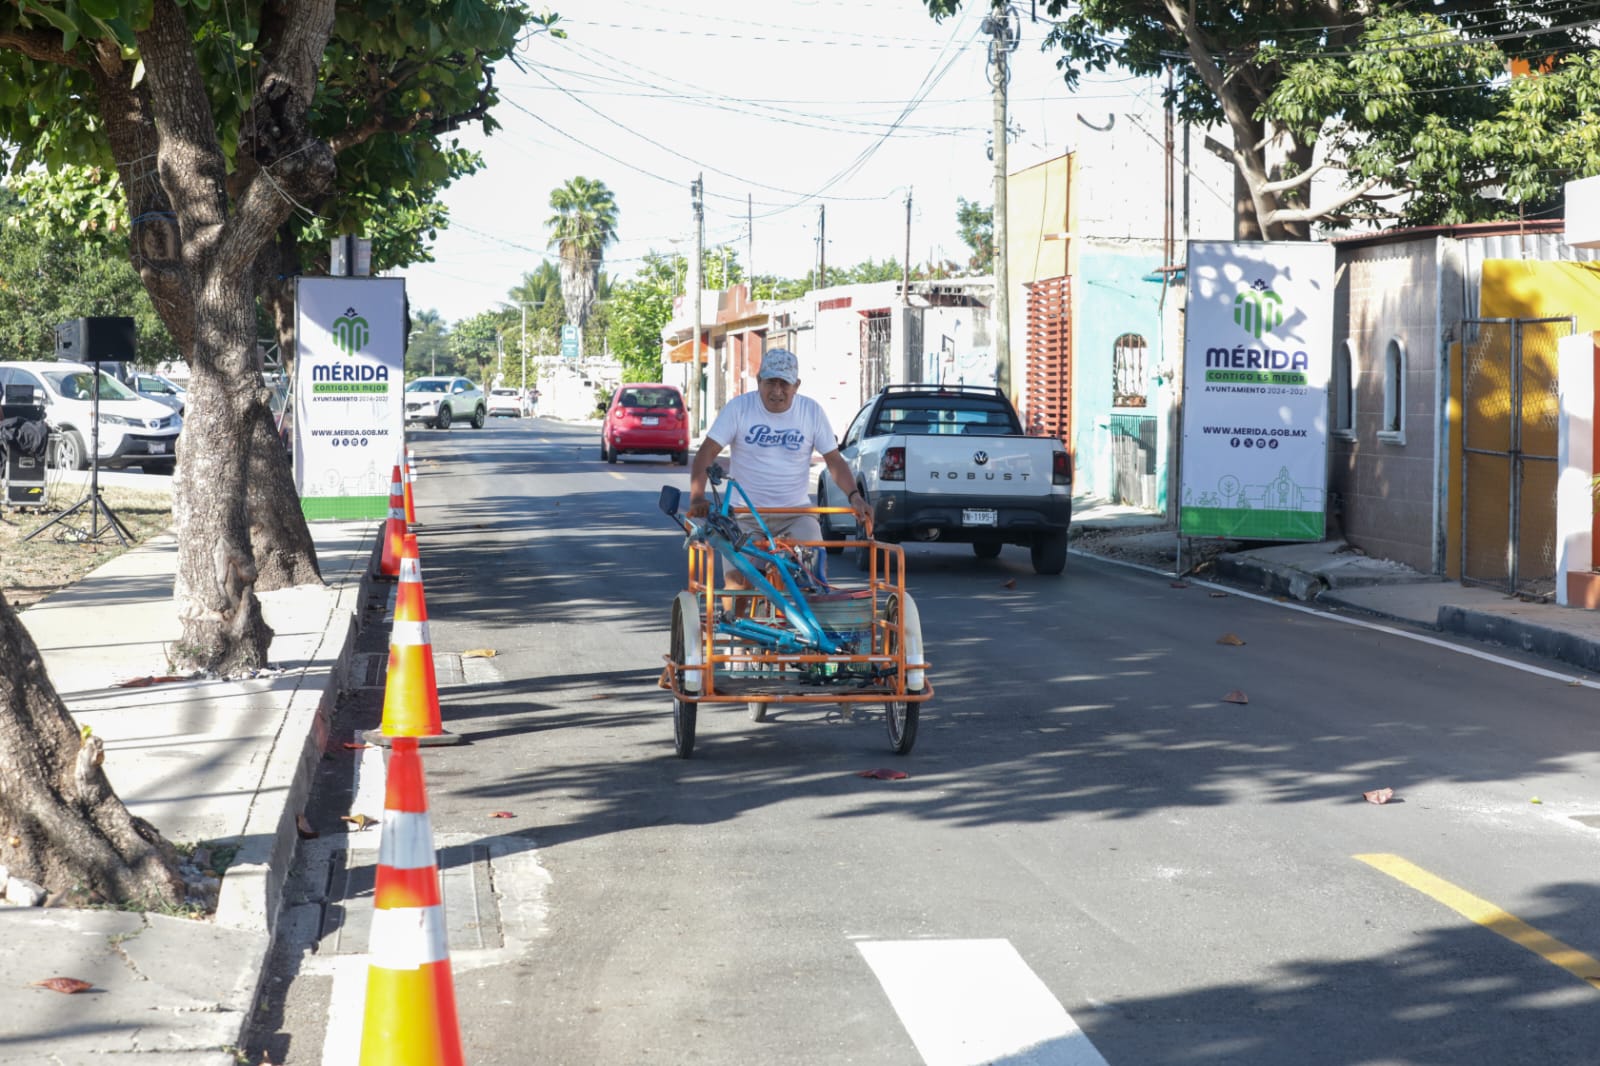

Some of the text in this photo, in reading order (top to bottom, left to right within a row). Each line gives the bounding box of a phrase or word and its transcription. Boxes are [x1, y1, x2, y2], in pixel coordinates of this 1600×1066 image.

[1205, 344, 1309, 370] MÉRIDA
[312, 361, 388, 381] MÉRIDA
[1208, 372, 1254, 381] CONTIGO
[1205, 385, 1266, 394] AYUNTAMIENTO
[1203, 426, 1307, 437] WWW.MERIDA.GOB.MX
[930, 471, 1030, 481] ROBUST
